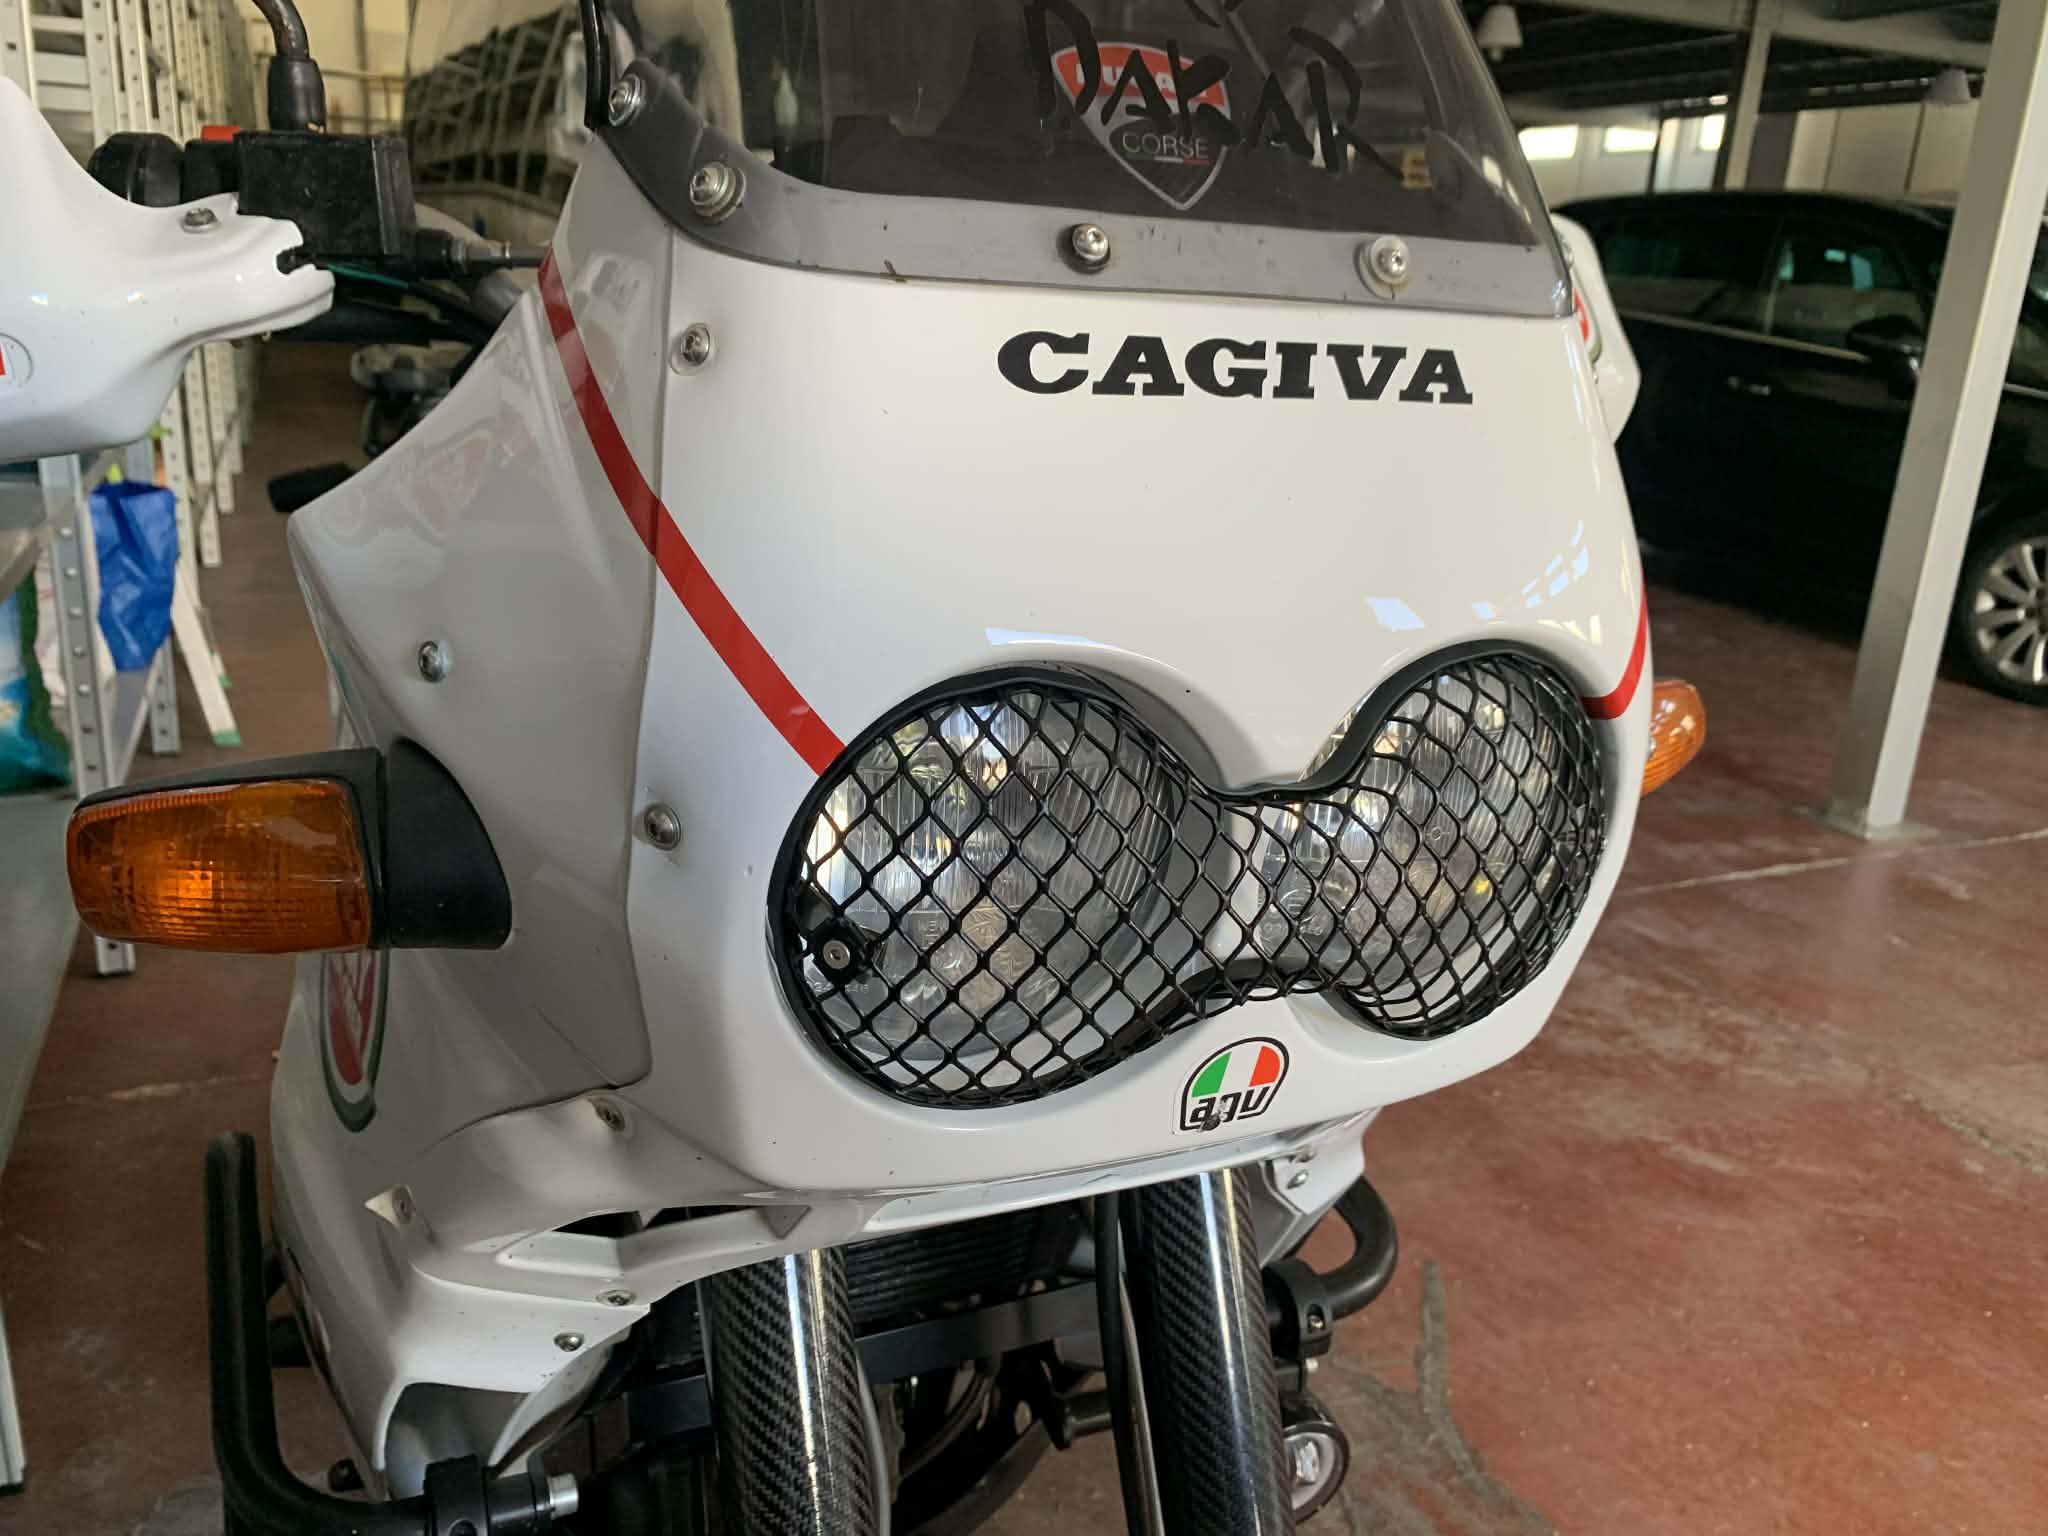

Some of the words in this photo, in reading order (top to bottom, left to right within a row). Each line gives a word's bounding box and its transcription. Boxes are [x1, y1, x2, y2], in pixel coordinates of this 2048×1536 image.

[1024, 0, 1404, 181] DAKAR
[1122, 131, 1209, 159] CORSE
[997, 330, 1474, 404] CAGIVA
